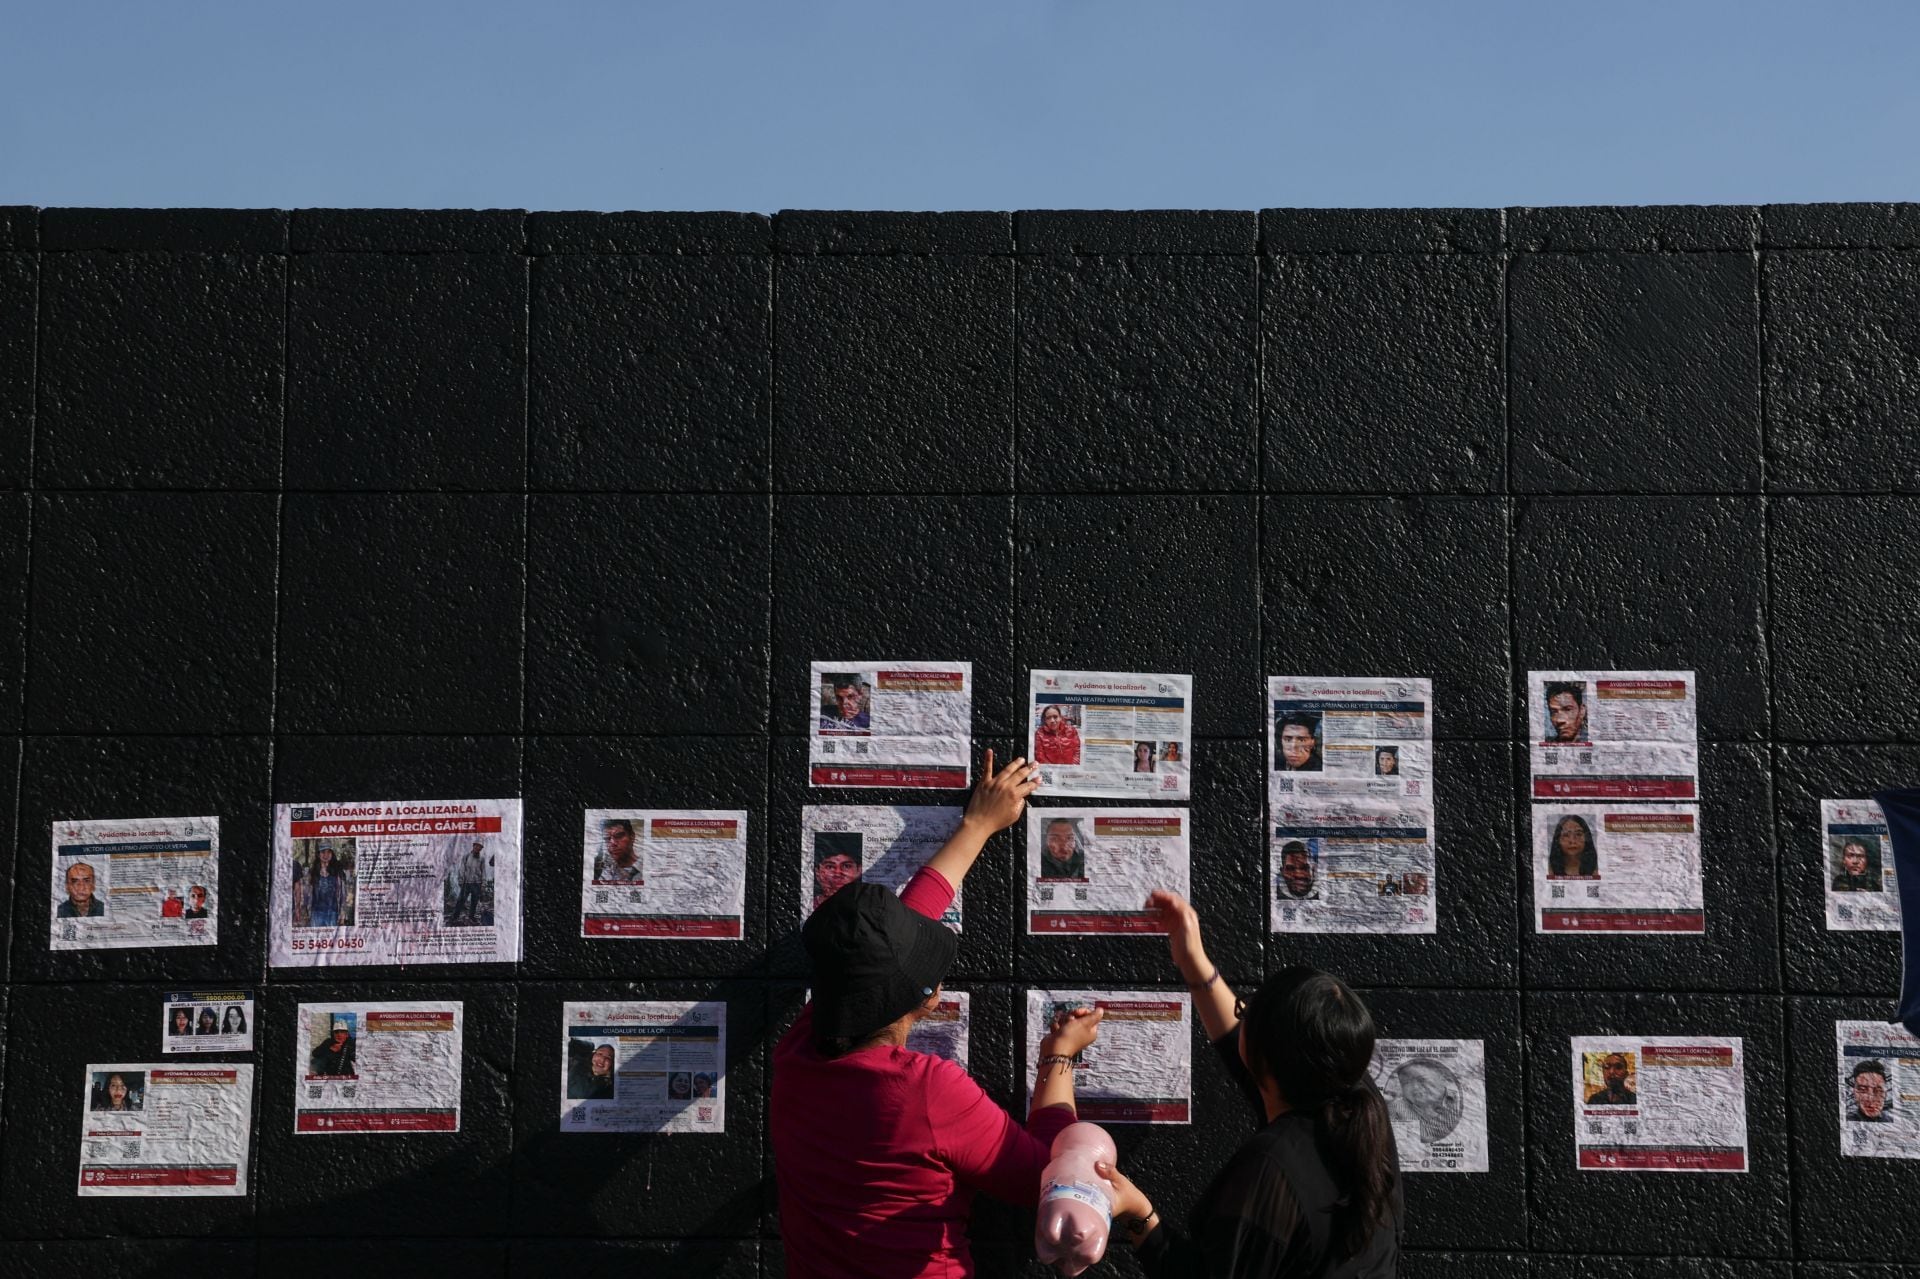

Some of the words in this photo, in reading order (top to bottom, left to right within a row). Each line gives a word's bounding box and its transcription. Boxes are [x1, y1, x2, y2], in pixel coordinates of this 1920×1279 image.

[316, 807, 382, 818] ¡AYÚDANOS
[385, 807, 393, 816] A
[396, 805, 476, 815] LOCALIZARLA!
[320, 824, 346, 834] ANA
[349, 823, 384, 832] AMELI
[388, 820, 432, 832] GARCÍA
[434, 820, 476, 830] GÁMEZ
[292, 940, 304, 950] 55
[308, 939, 334, 949] 5484
[338, 938, 364, 948] 0430
